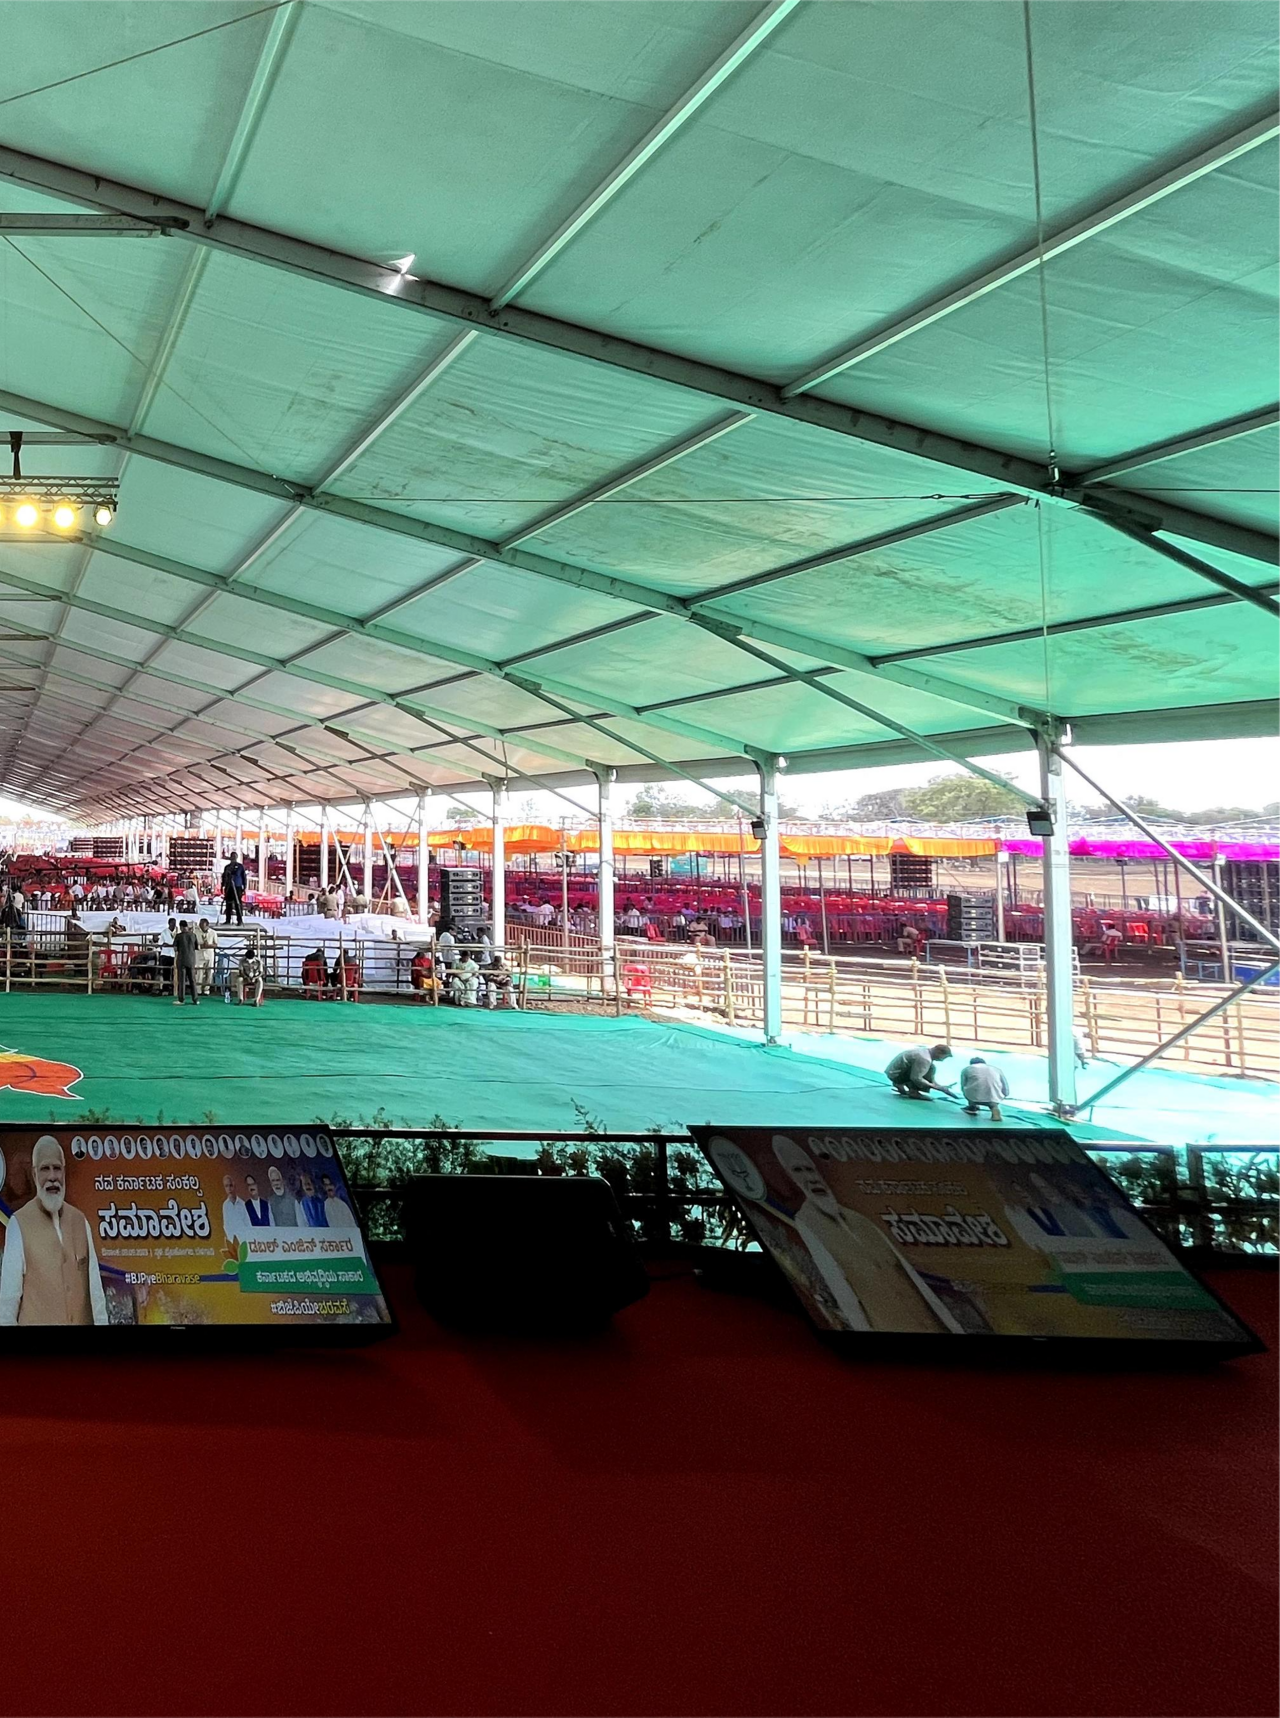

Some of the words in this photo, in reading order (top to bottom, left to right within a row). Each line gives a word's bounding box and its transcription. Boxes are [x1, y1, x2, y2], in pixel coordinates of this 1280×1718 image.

[95, 1174, 114, 1190] ನವ
[116, 1174, 163, 1190] ಕರ್ನಾಟಕ
[166, 1174, 203, 1196] ಸಂಕಲ್ಪ
[98, 1199, 210, 1238] ಸಮಾವೇಶ
[248, 1239, 279, 1253] ಡಬಲ್
[320, 1237, 353, 1252] ಸರ್ಕಾರ
[125, 1272, 200, 1285] #BJPyeBharavase
[256, 1269, 295, 1283] ಕರ್ನಾಟಕದ
